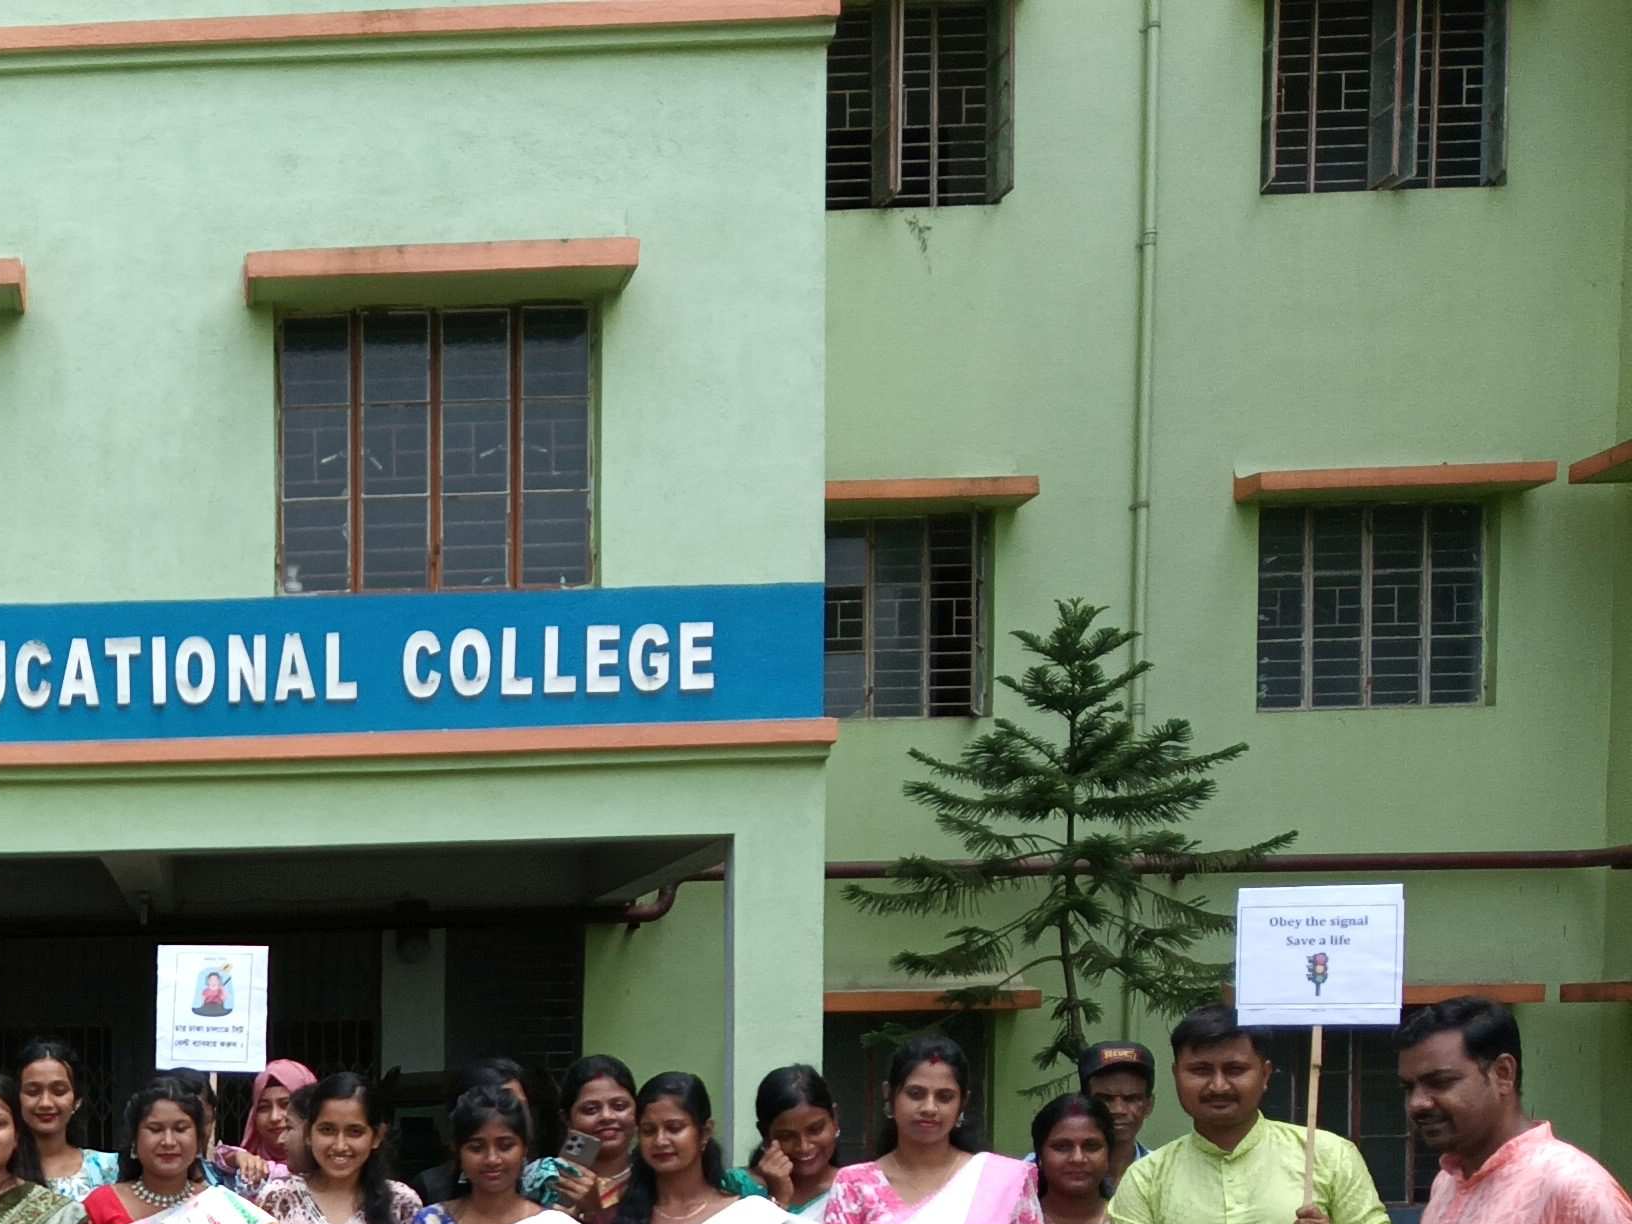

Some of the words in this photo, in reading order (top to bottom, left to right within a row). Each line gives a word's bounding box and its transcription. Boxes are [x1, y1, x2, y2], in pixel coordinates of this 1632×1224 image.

[402, 621, 716, 698] COLLEGE
[1269, 916, 1302, 928] Obey
[1305, 916, 1326, 926] the
[1330, 915, 1369, 928] signal
[1286, 935, 1316, 946] Save
[1319, 938, 1326, 946] a
[1330, 934, 1351, 946] life
